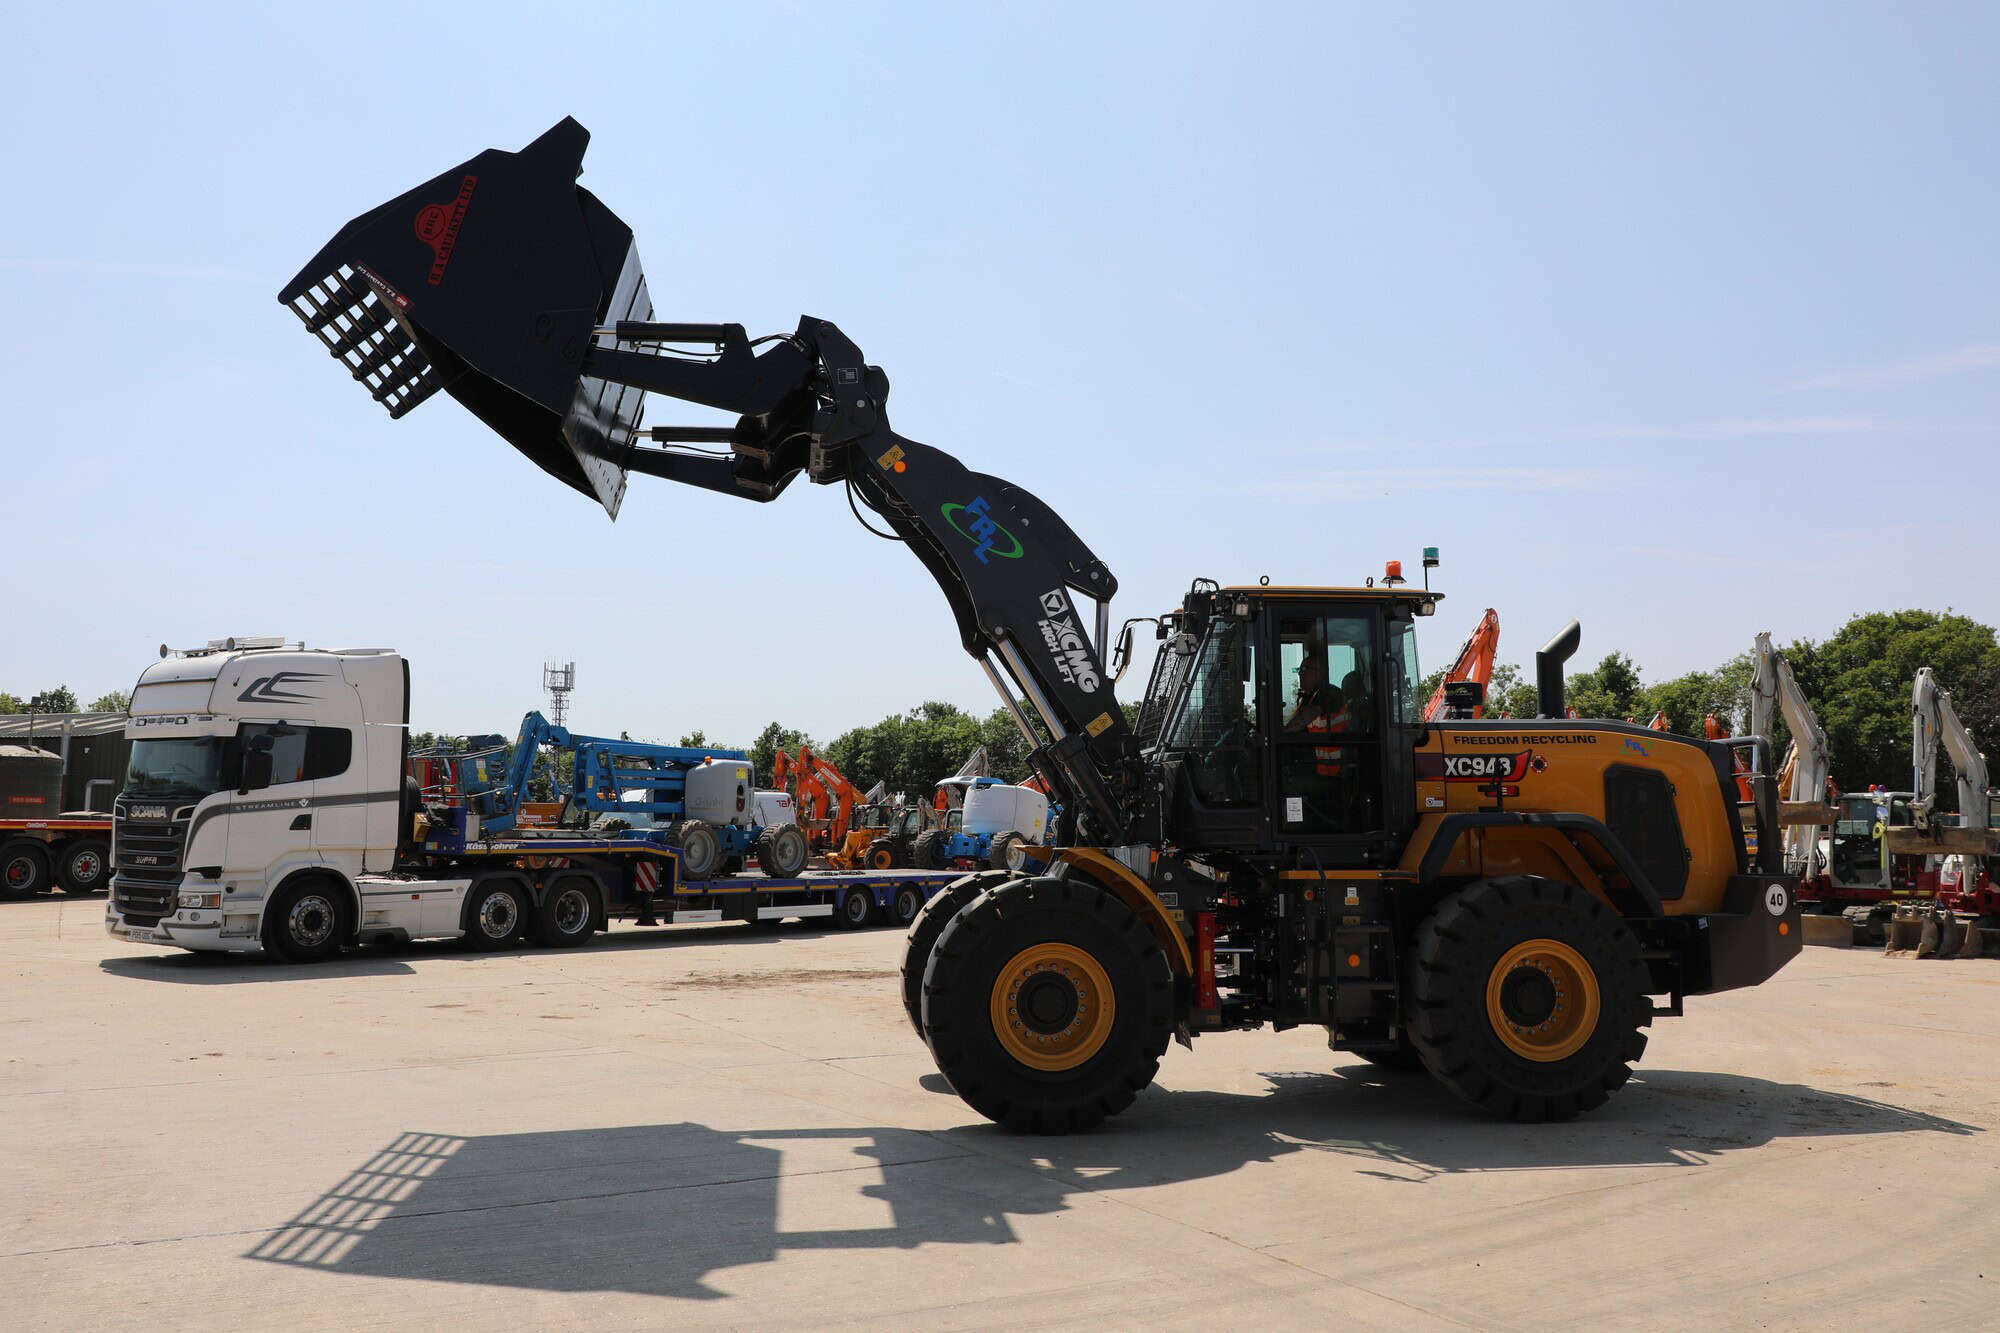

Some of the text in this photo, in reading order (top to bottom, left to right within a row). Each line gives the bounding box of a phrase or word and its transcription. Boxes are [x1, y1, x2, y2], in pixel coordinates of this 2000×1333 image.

[461, 179, 473, 201] LTD
[964, 496, 996, 566] FRL
[1037, 619, 1076, 684] HIGH LIFT
[1050, 615, 1100, 694] XCMG
[1454, 736, 1597, 744] FREEDOM RECYCLING
[1624, 738, 1648, 756] FRL
[130, 805, 167, 818] SCANIA
[234, 801, 295, 810] STREAMLINE
[136, 855, 157, 865] SUPER
[1770, 893, 1783, 906] 40
